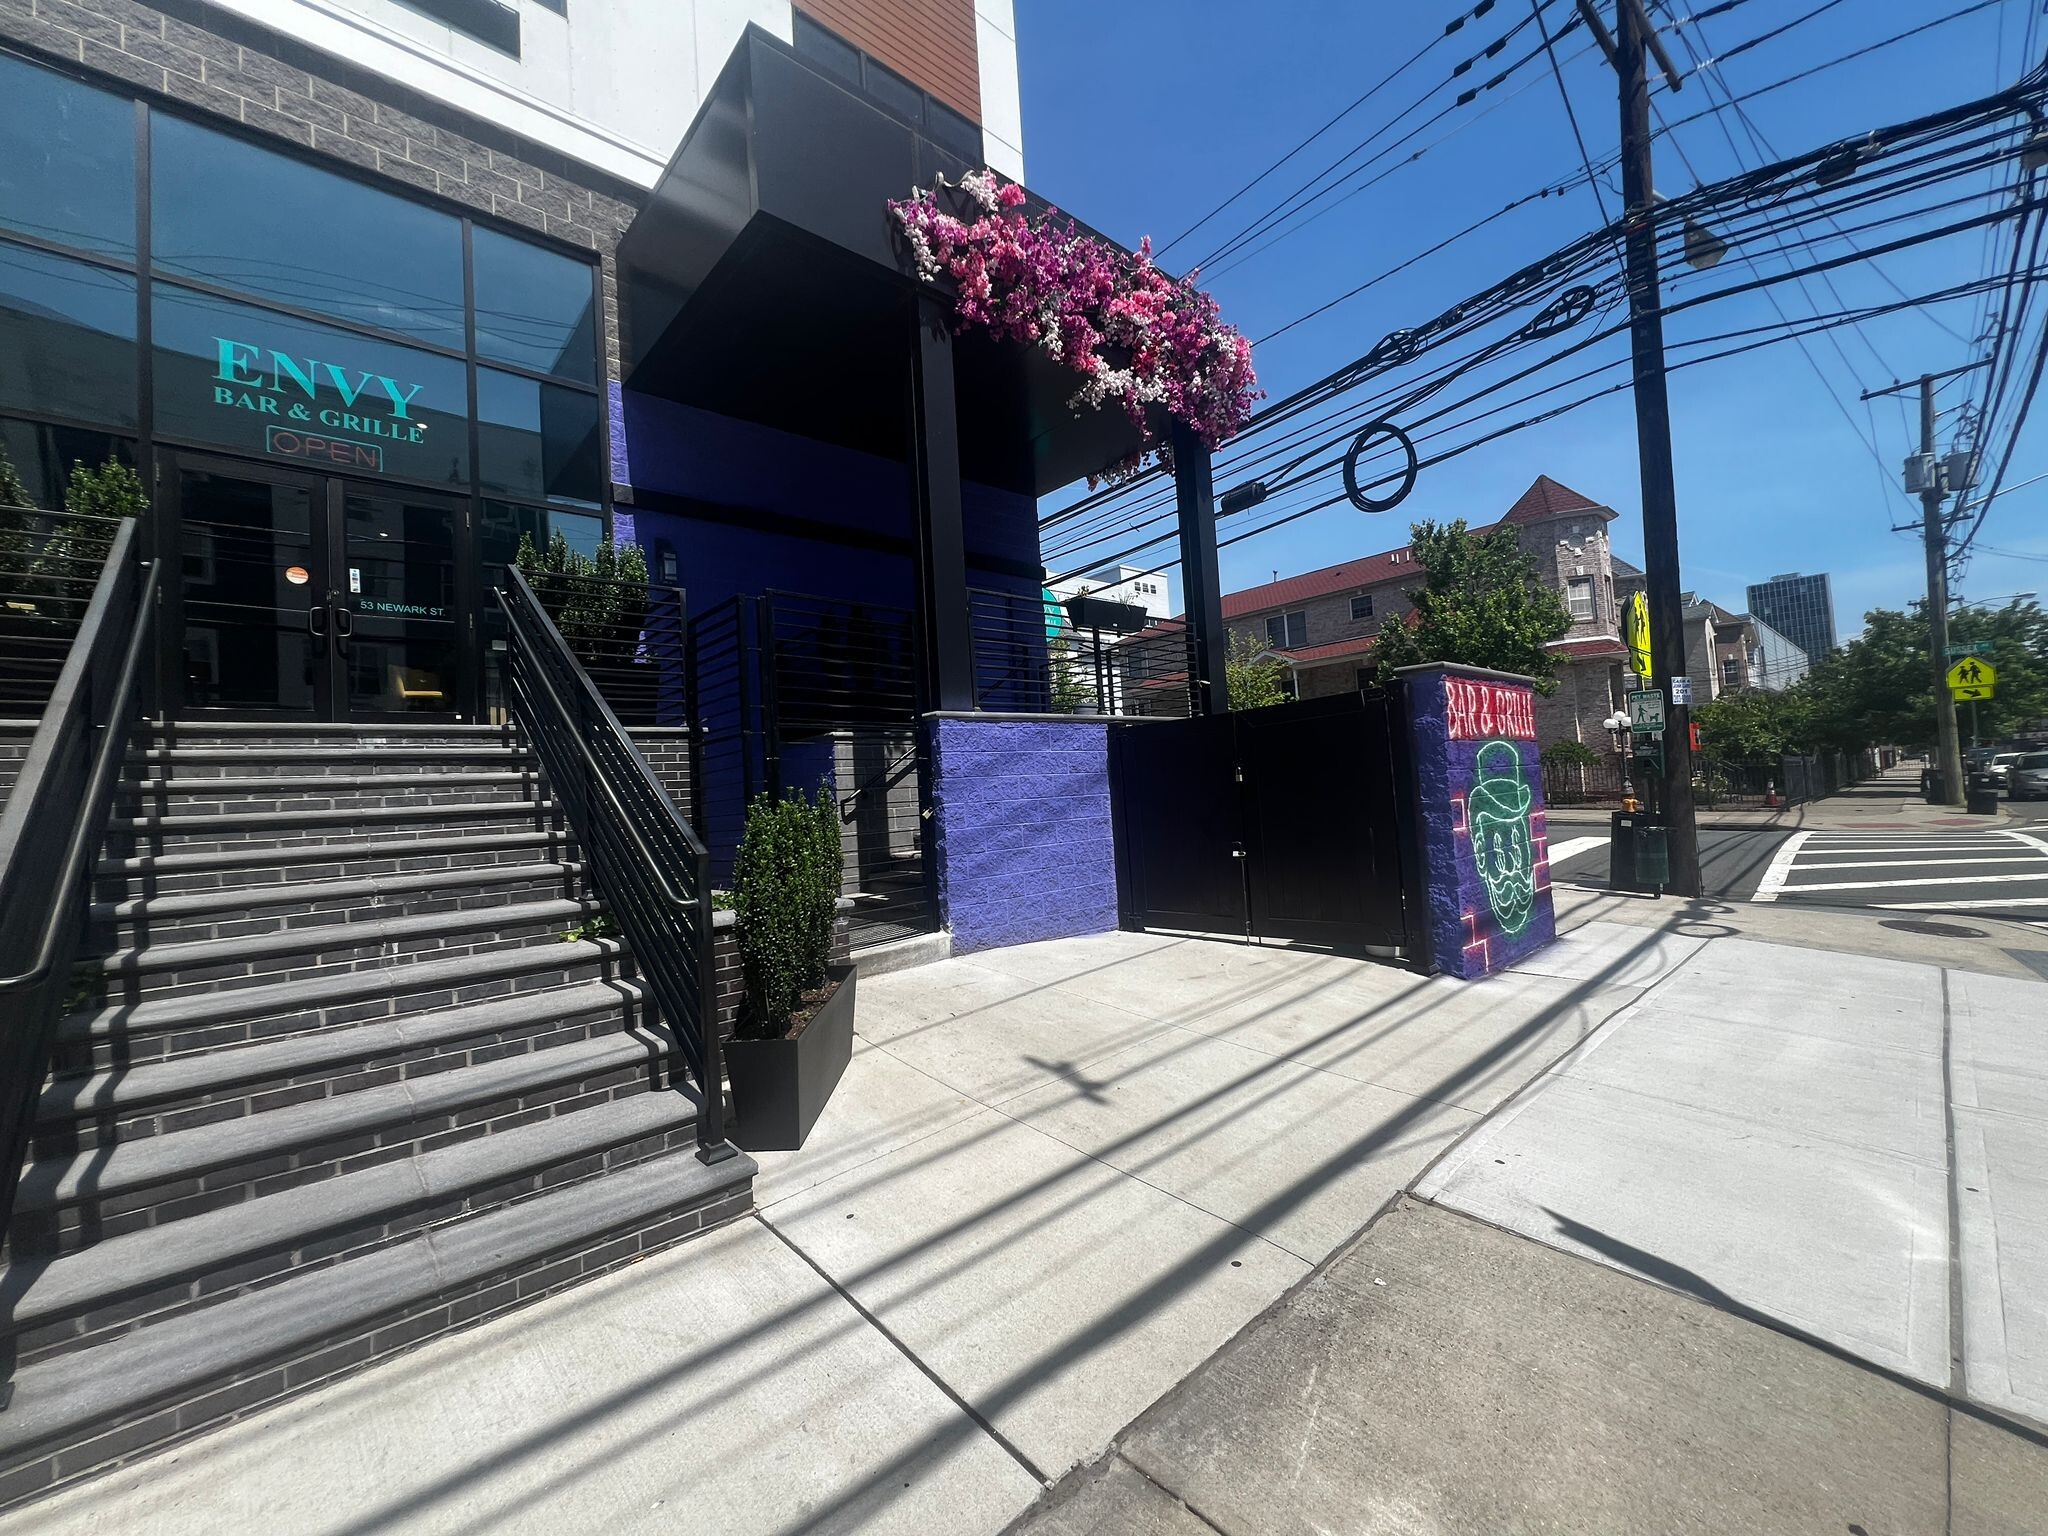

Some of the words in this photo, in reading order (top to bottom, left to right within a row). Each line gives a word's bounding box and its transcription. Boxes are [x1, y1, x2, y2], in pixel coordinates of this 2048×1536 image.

[210, 336, 424, 421] ENVY
[213, 386, 280, 416] BAR
[287, 403, 312, 422] &
[319, 409, 424, 444] GRILLE
[272, 431, 376, 467] OPEN
[360, 601, 374, 610] 53
[376, 602, 427, 615] NEWARK
[1445, 681, 1478, 740] BAR
[1480, 685, 1494, 735] &
[1495, 690, 1536, 738] GRILLE
